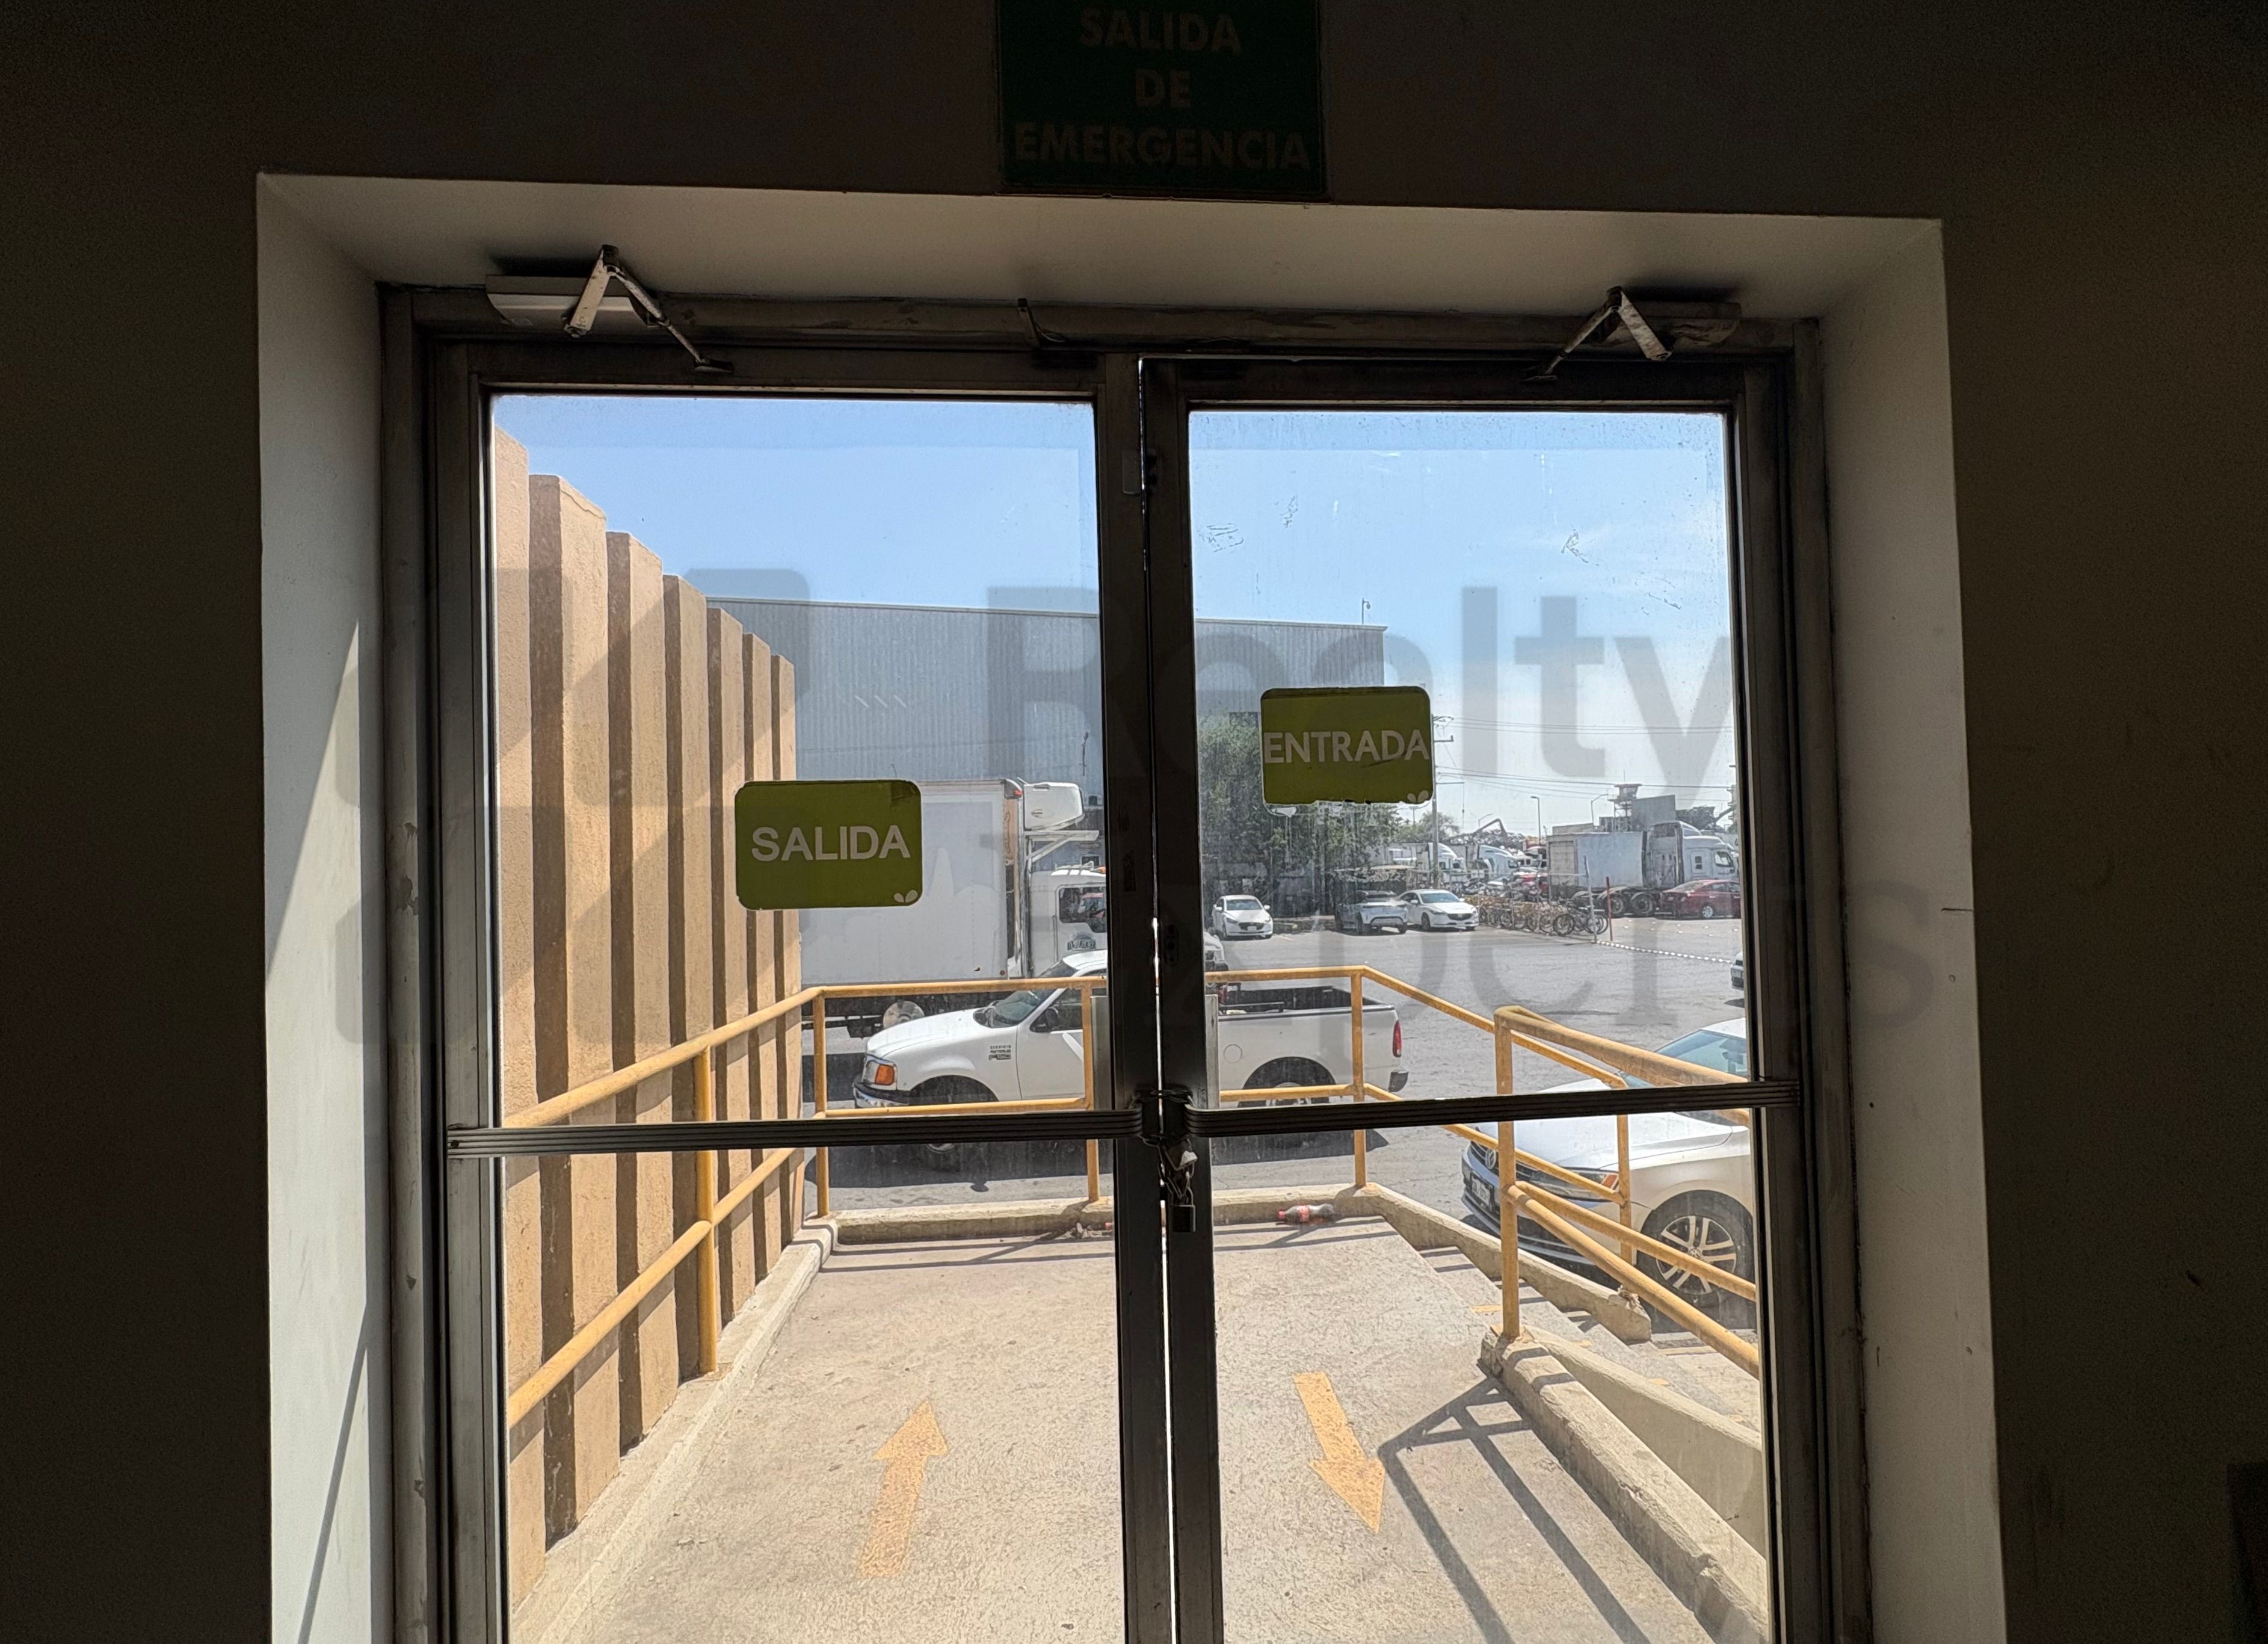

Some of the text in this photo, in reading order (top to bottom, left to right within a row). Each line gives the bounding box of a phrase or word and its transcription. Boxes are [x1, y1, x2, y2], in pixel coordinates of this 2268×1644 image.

[1079, 7, 1242, 57] SALIDA
[1135, 67, 1193, 108] DE
[1014, 121, 1310, 170] EMERGENCIA
[1264, 729, 1430, 764] ENTRADA
[751, 825, 911, 861] SALIDA
